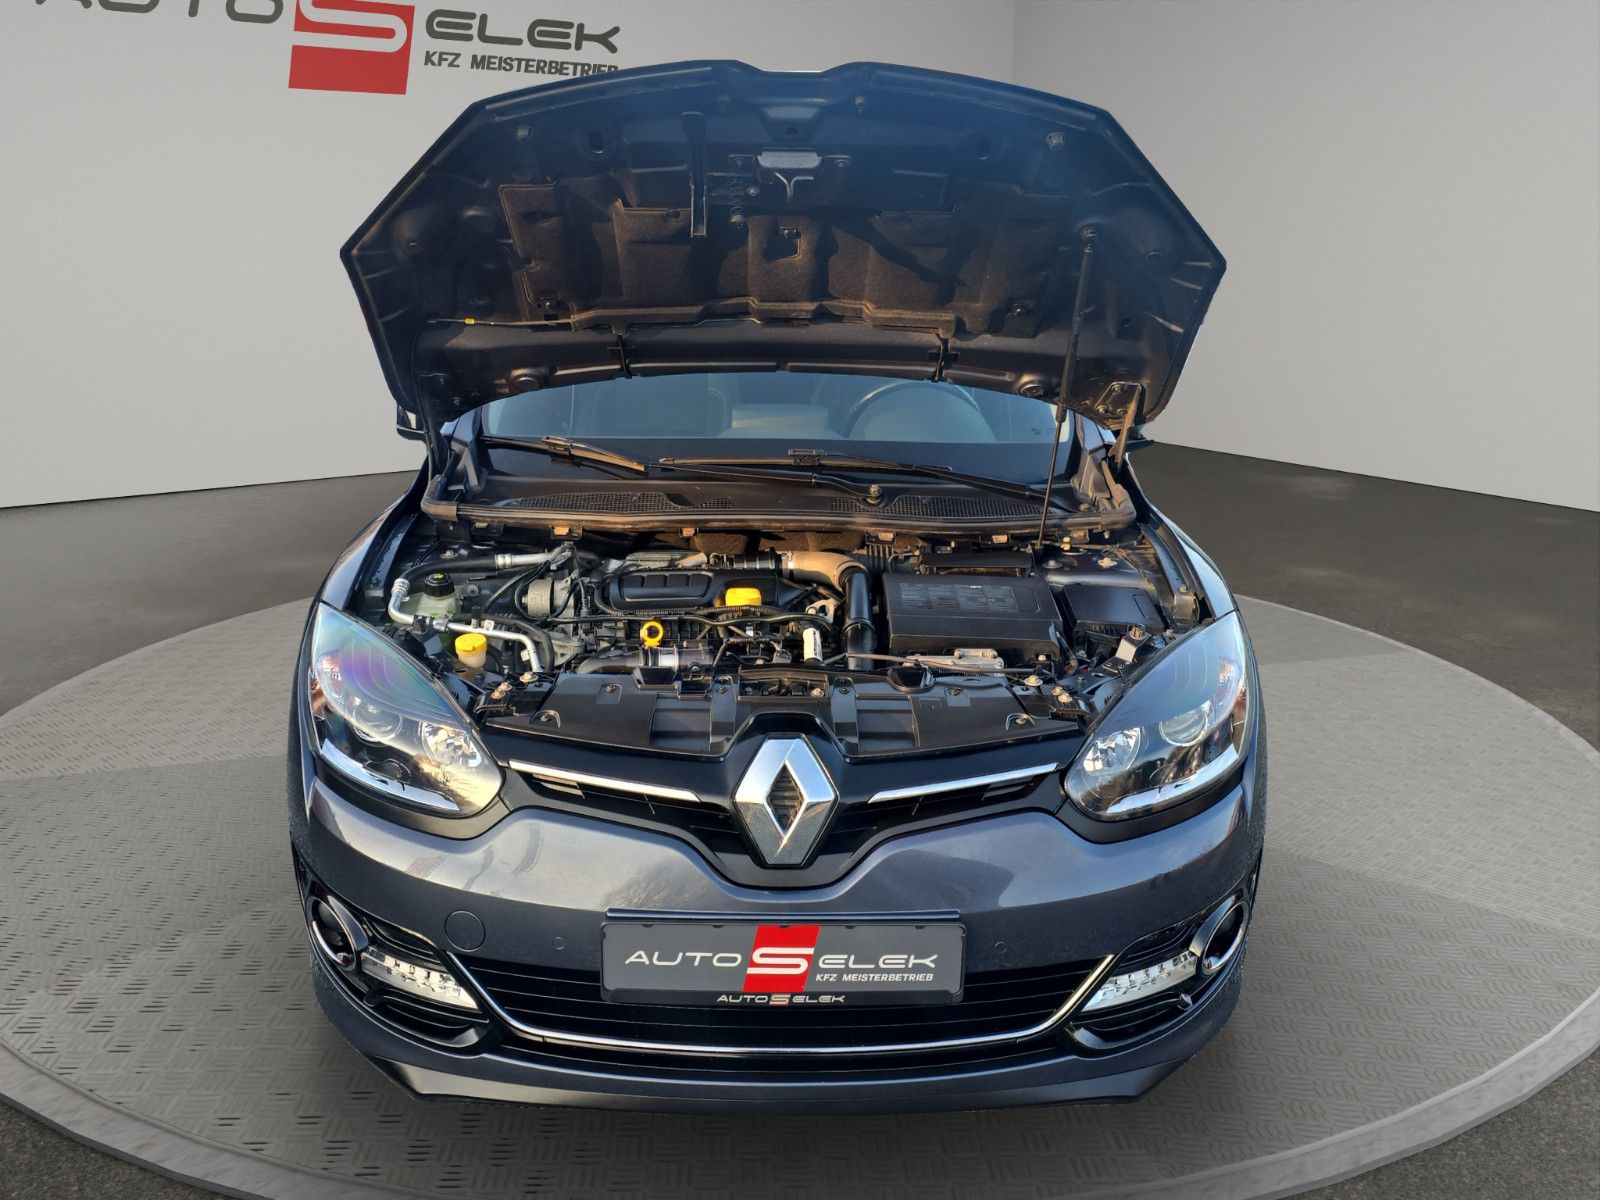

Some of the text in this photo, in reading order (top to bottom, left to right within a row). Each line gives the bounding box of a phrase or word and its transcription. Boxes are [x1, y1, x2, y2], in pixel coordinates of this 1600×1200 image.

[423, 50, 461, 69] KFZ
[815, 973, 934, 982] KFZ MEISTERBETRIEB
